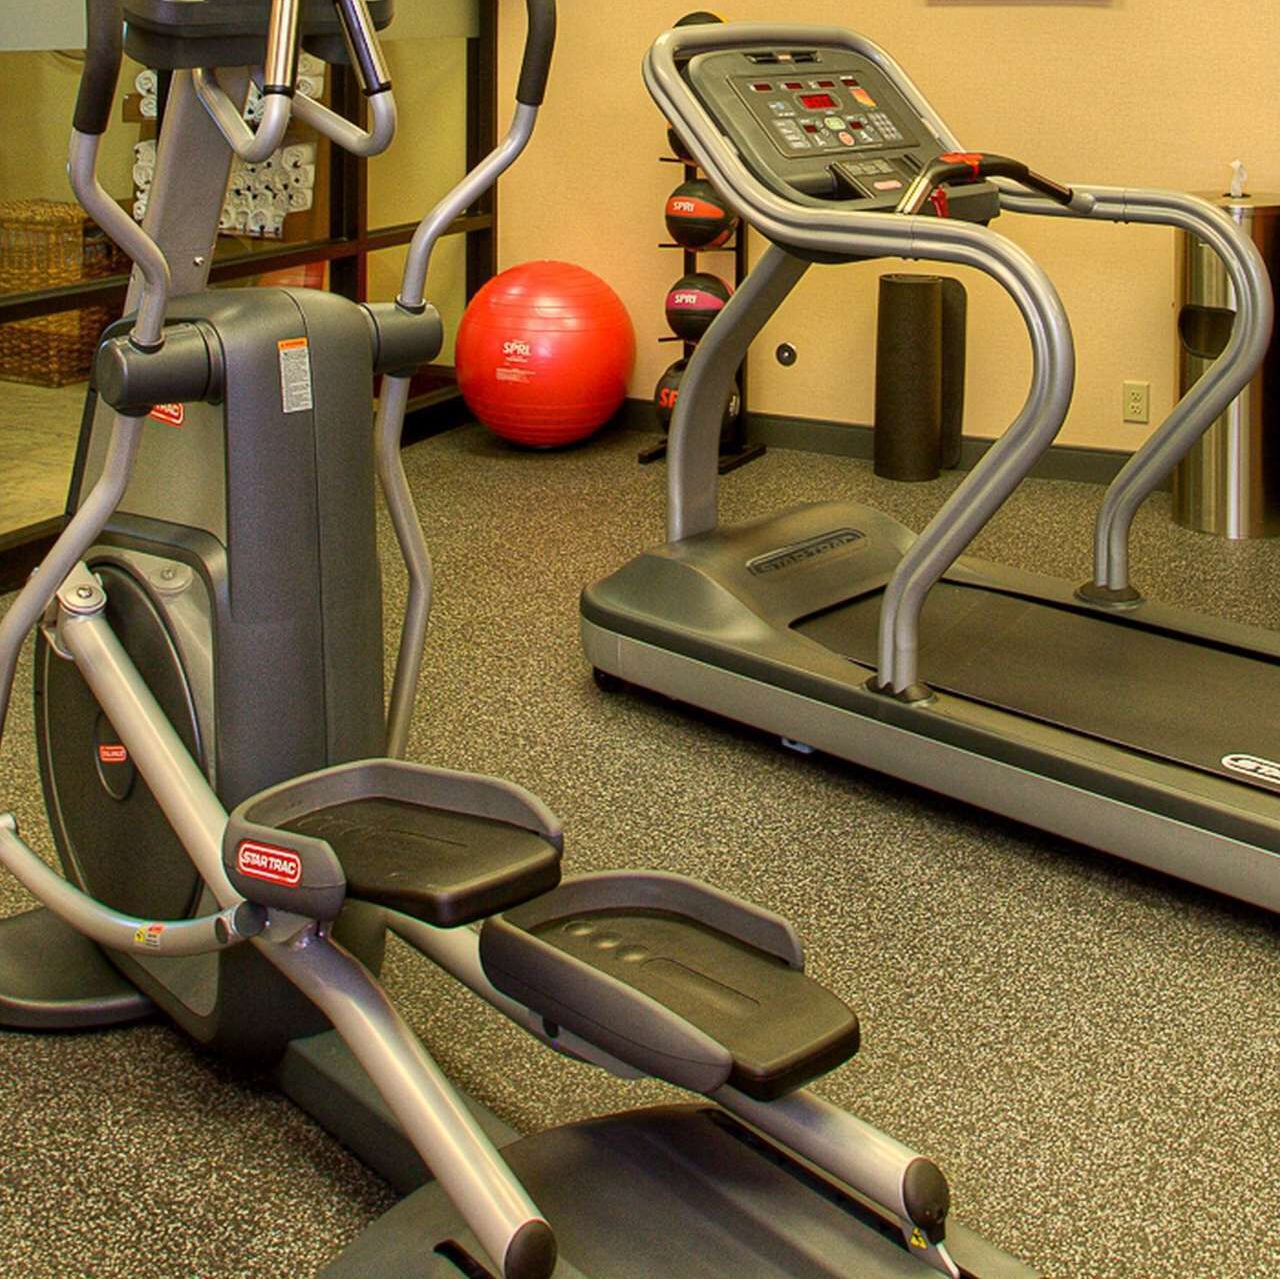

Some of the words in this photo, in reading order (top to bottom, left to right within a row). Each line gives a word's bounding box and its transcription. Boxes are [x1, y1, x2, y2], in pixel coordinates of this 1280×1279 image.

[674, 293, 697, 305] SPRI
[242, 851, 267, 868] STAR
[268, 857, 297, 875] TRAC
